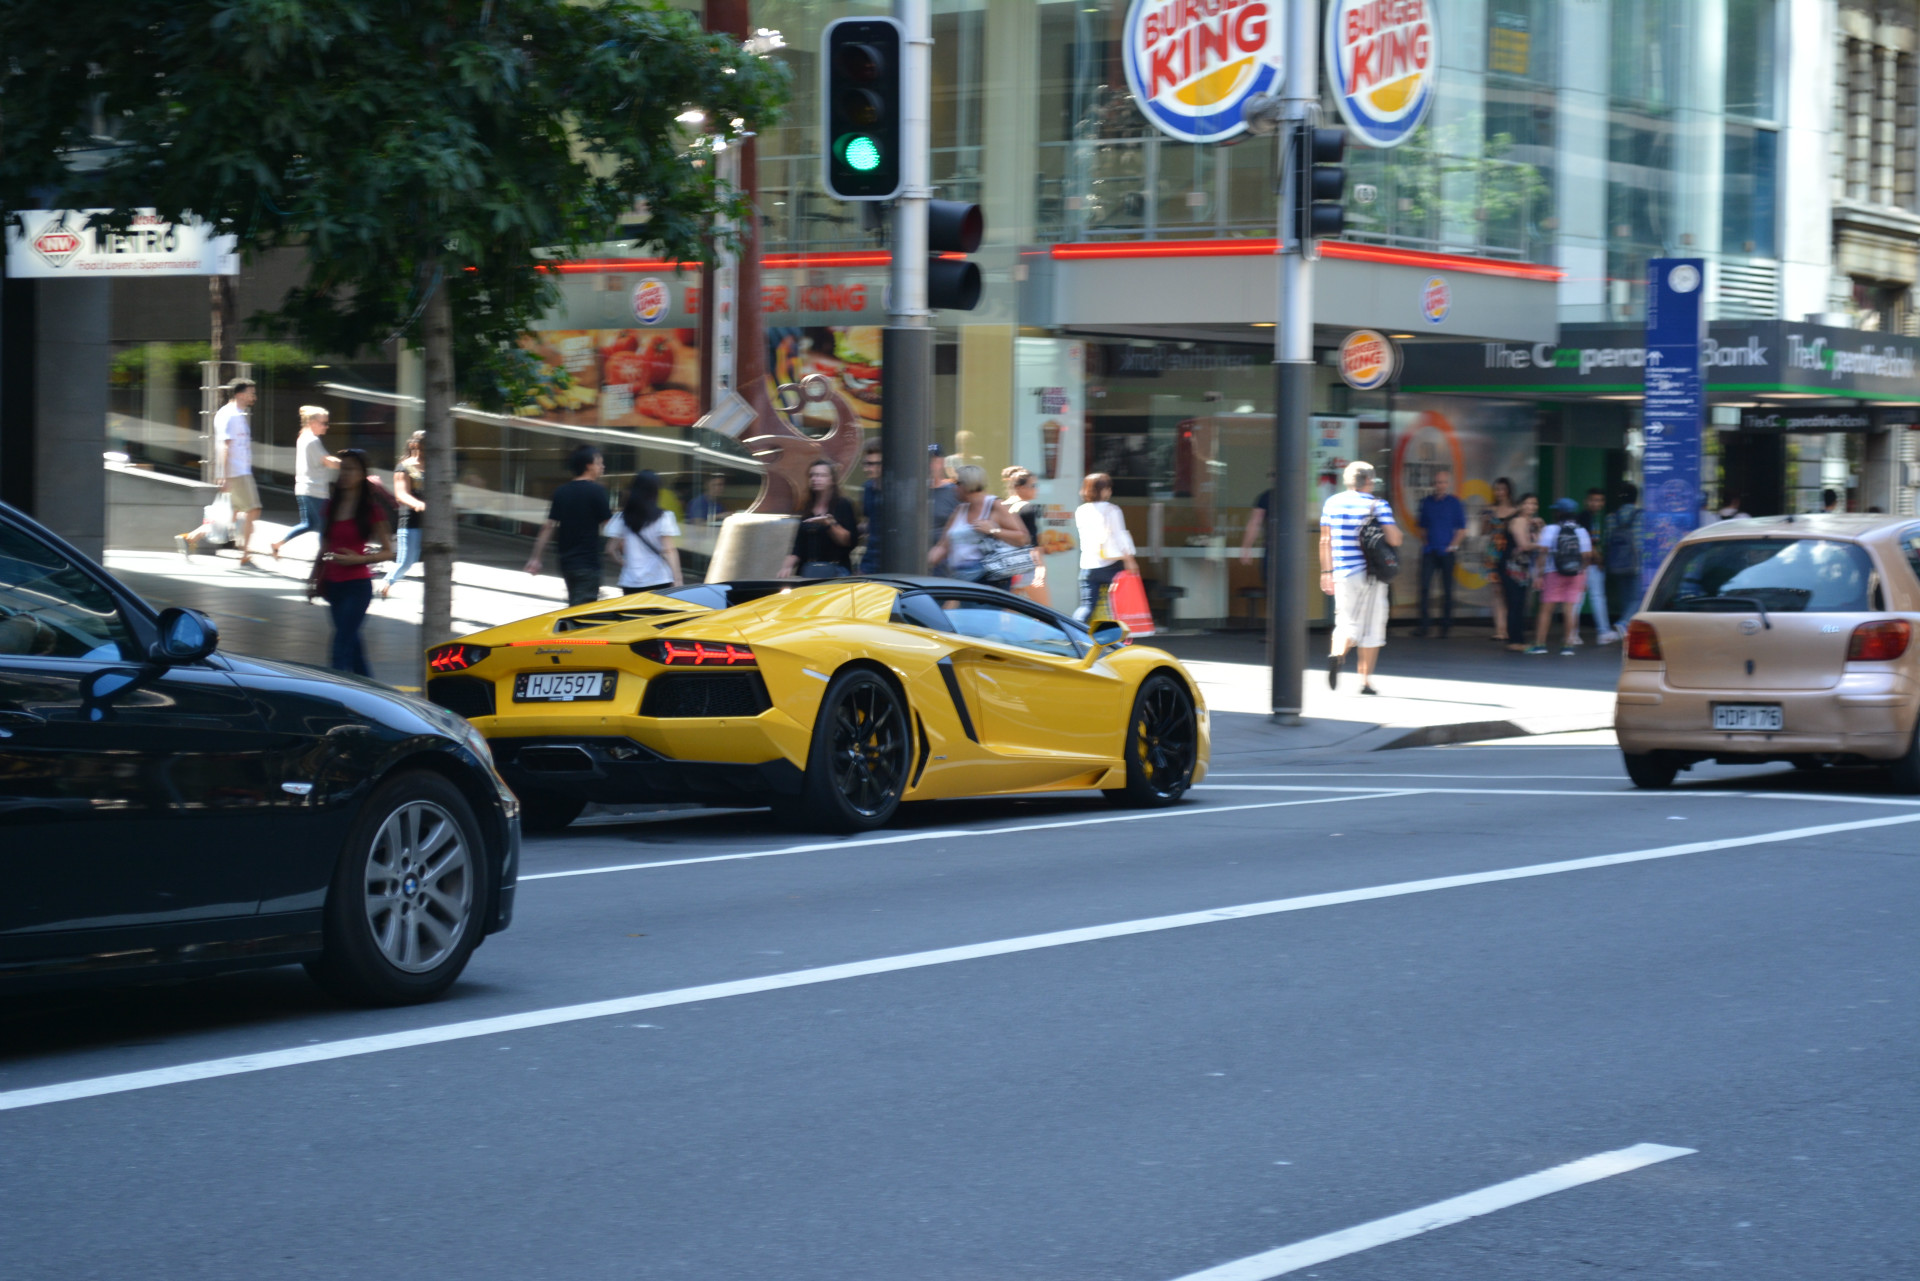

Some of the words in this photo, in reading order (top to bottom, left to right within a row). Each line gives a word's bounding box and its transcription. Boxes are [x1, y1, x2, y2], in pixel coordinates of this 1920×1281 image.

[1143, 0, 1248, 51] BURG
[1147, 3, 1268, 100] KING
[1345, 23, 1429, 96] KING
[797, 283, 868, 313] KING
[1485, 341, 1530, 368] The
[532, 675, 596, 695] HJZ597
[1714, 709, 1782, 726] HDP176
